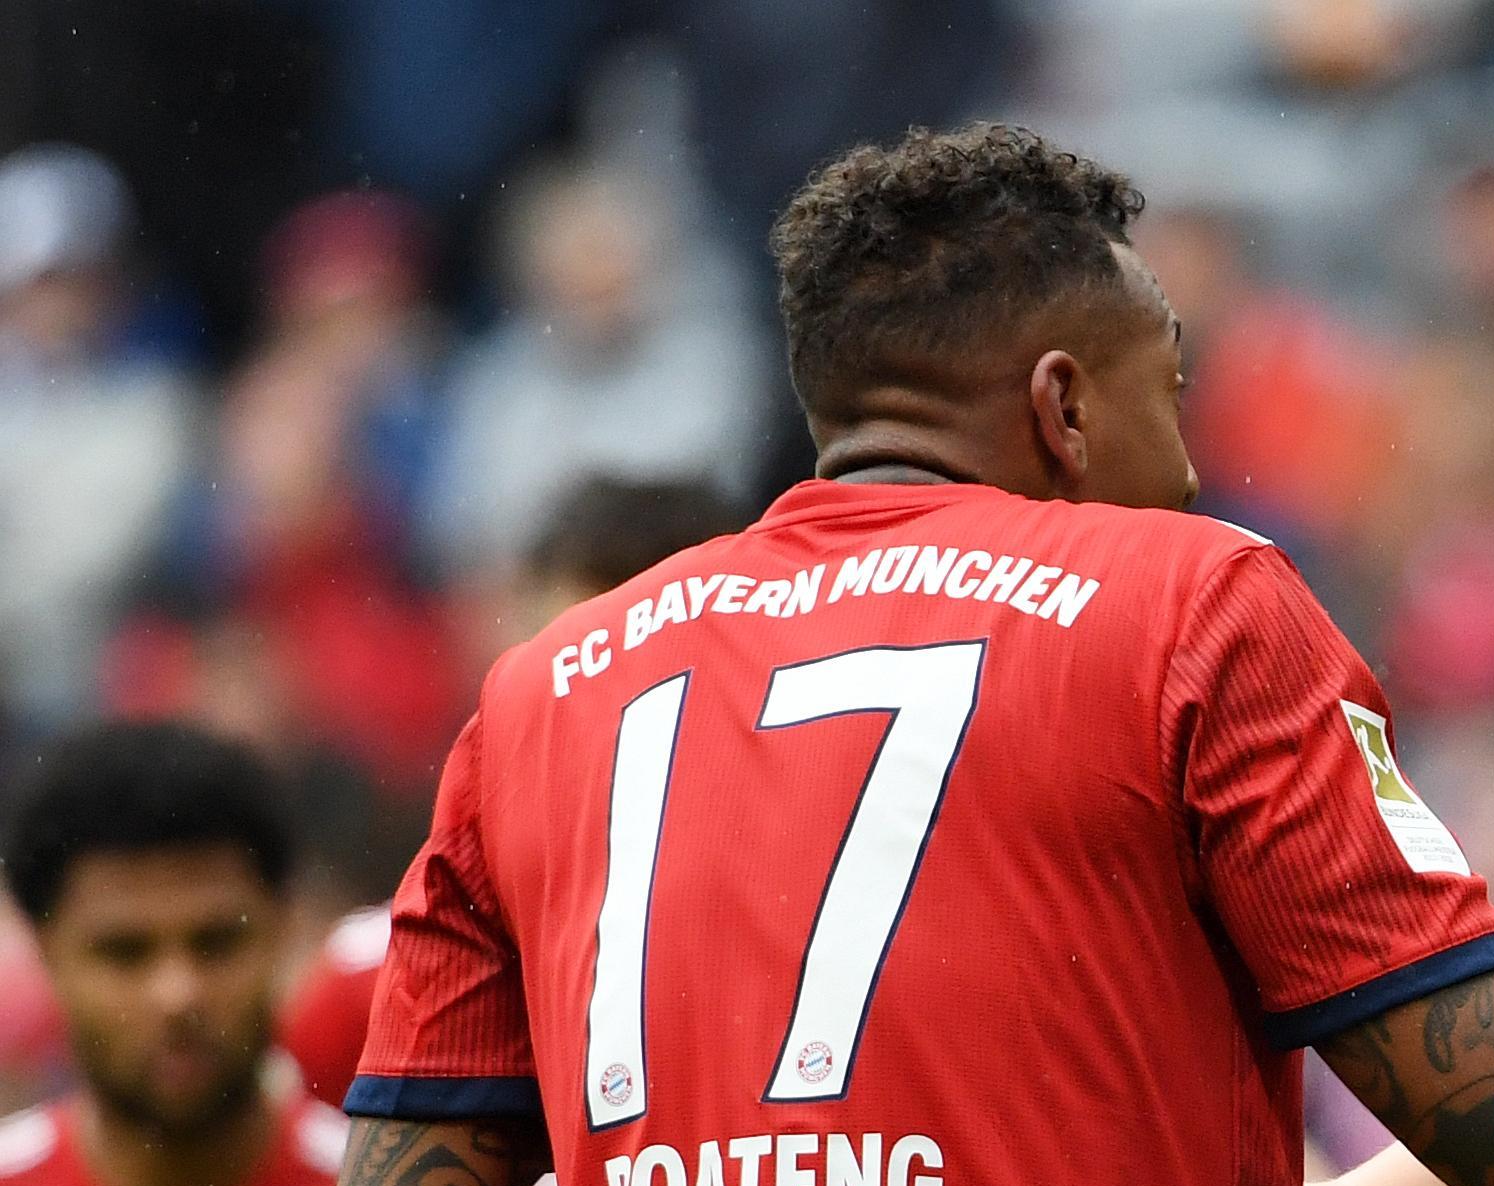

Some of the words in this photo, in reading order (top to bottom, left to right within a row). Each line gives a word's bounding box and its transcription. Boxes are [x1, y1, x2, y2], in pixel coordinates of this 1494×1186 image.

[551, 630, 612, 698] FC
[623, 564, 825, 651] BAYERN
[827, 545, 1101, 629] MÜNCHEN
[584, 637, 988, 1131] 17
